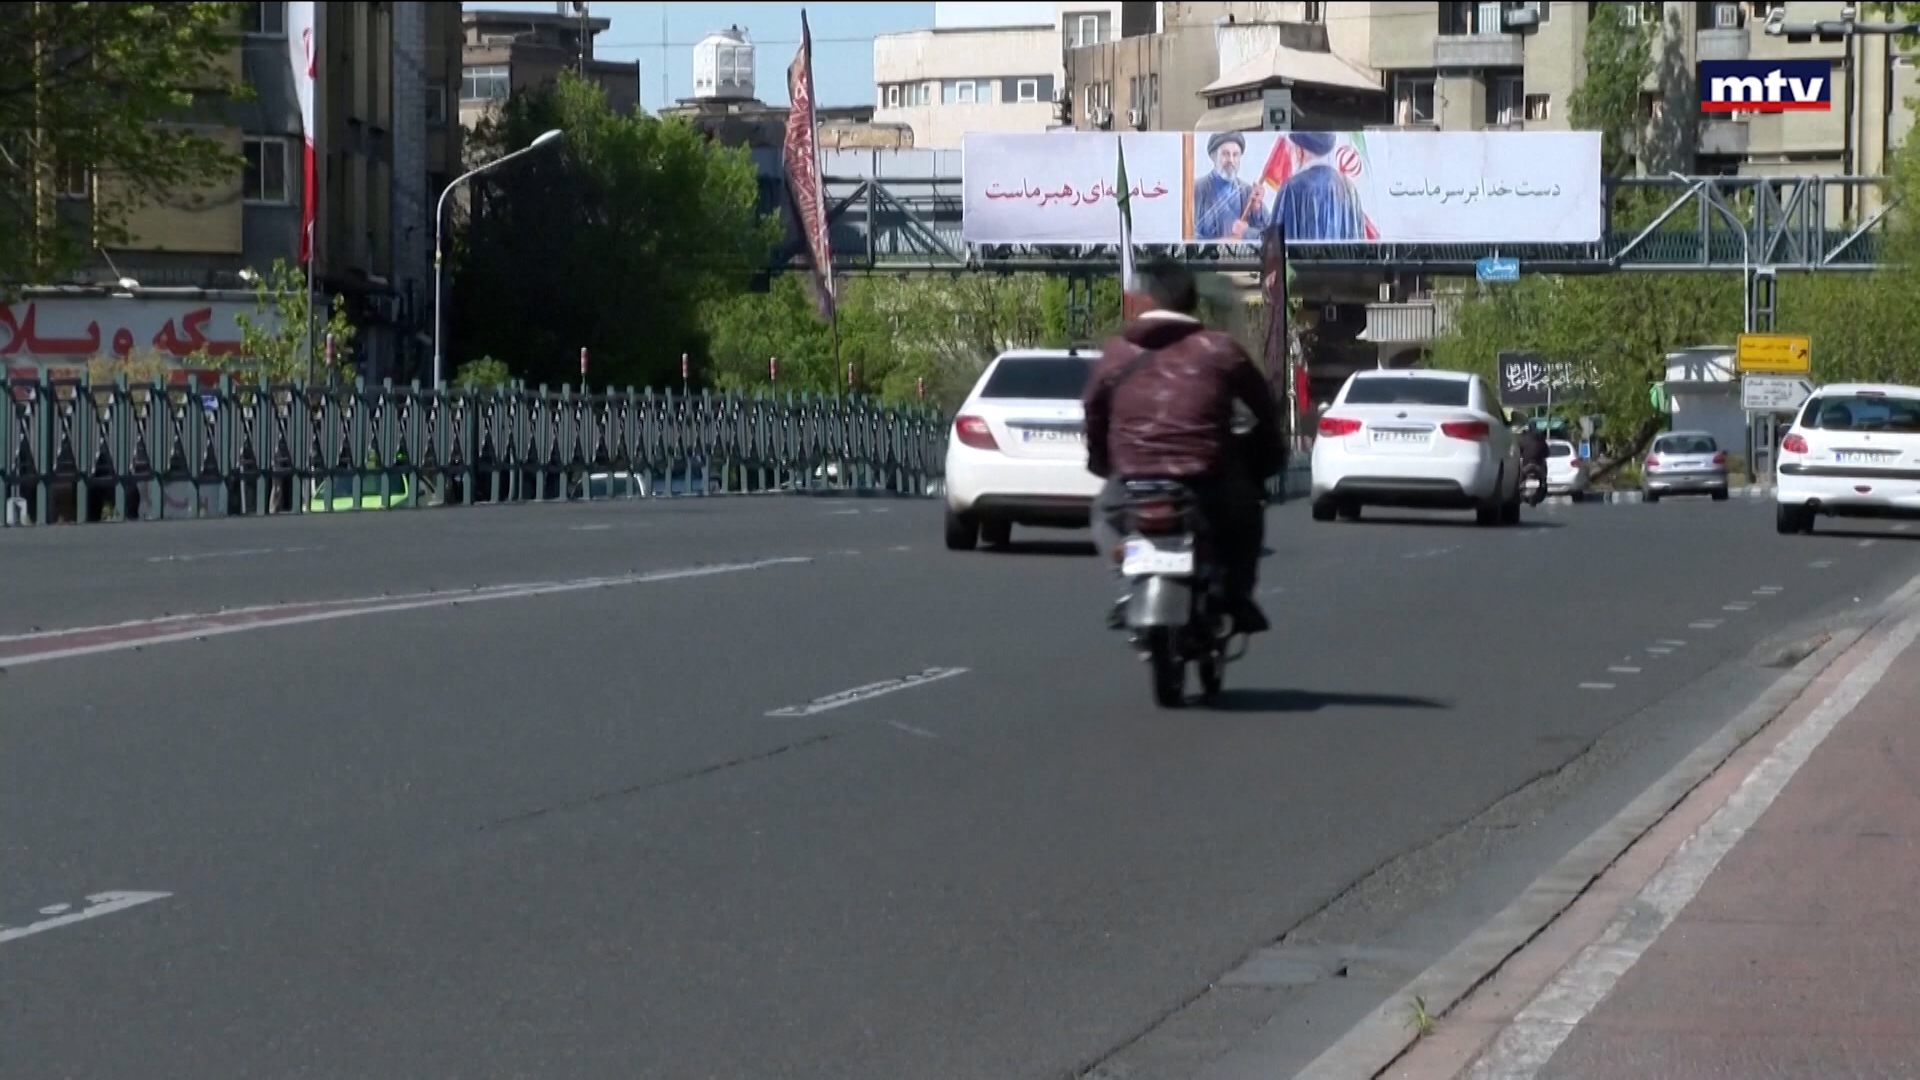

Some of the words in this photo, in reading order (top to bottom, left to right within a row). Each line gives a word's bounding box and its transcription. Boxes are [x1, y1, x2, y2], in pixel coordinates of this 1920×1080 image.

[1038, 183, 1079, 206] رهبر
[1082, 177, 1169, 204] خامه‌ای
[1439, 187, 1465, 204] سر
[1463, 184, 1480, 204] بر
[1481, 177, 1512, 197] خدا
[1515, 181, 1561, 197] دست
